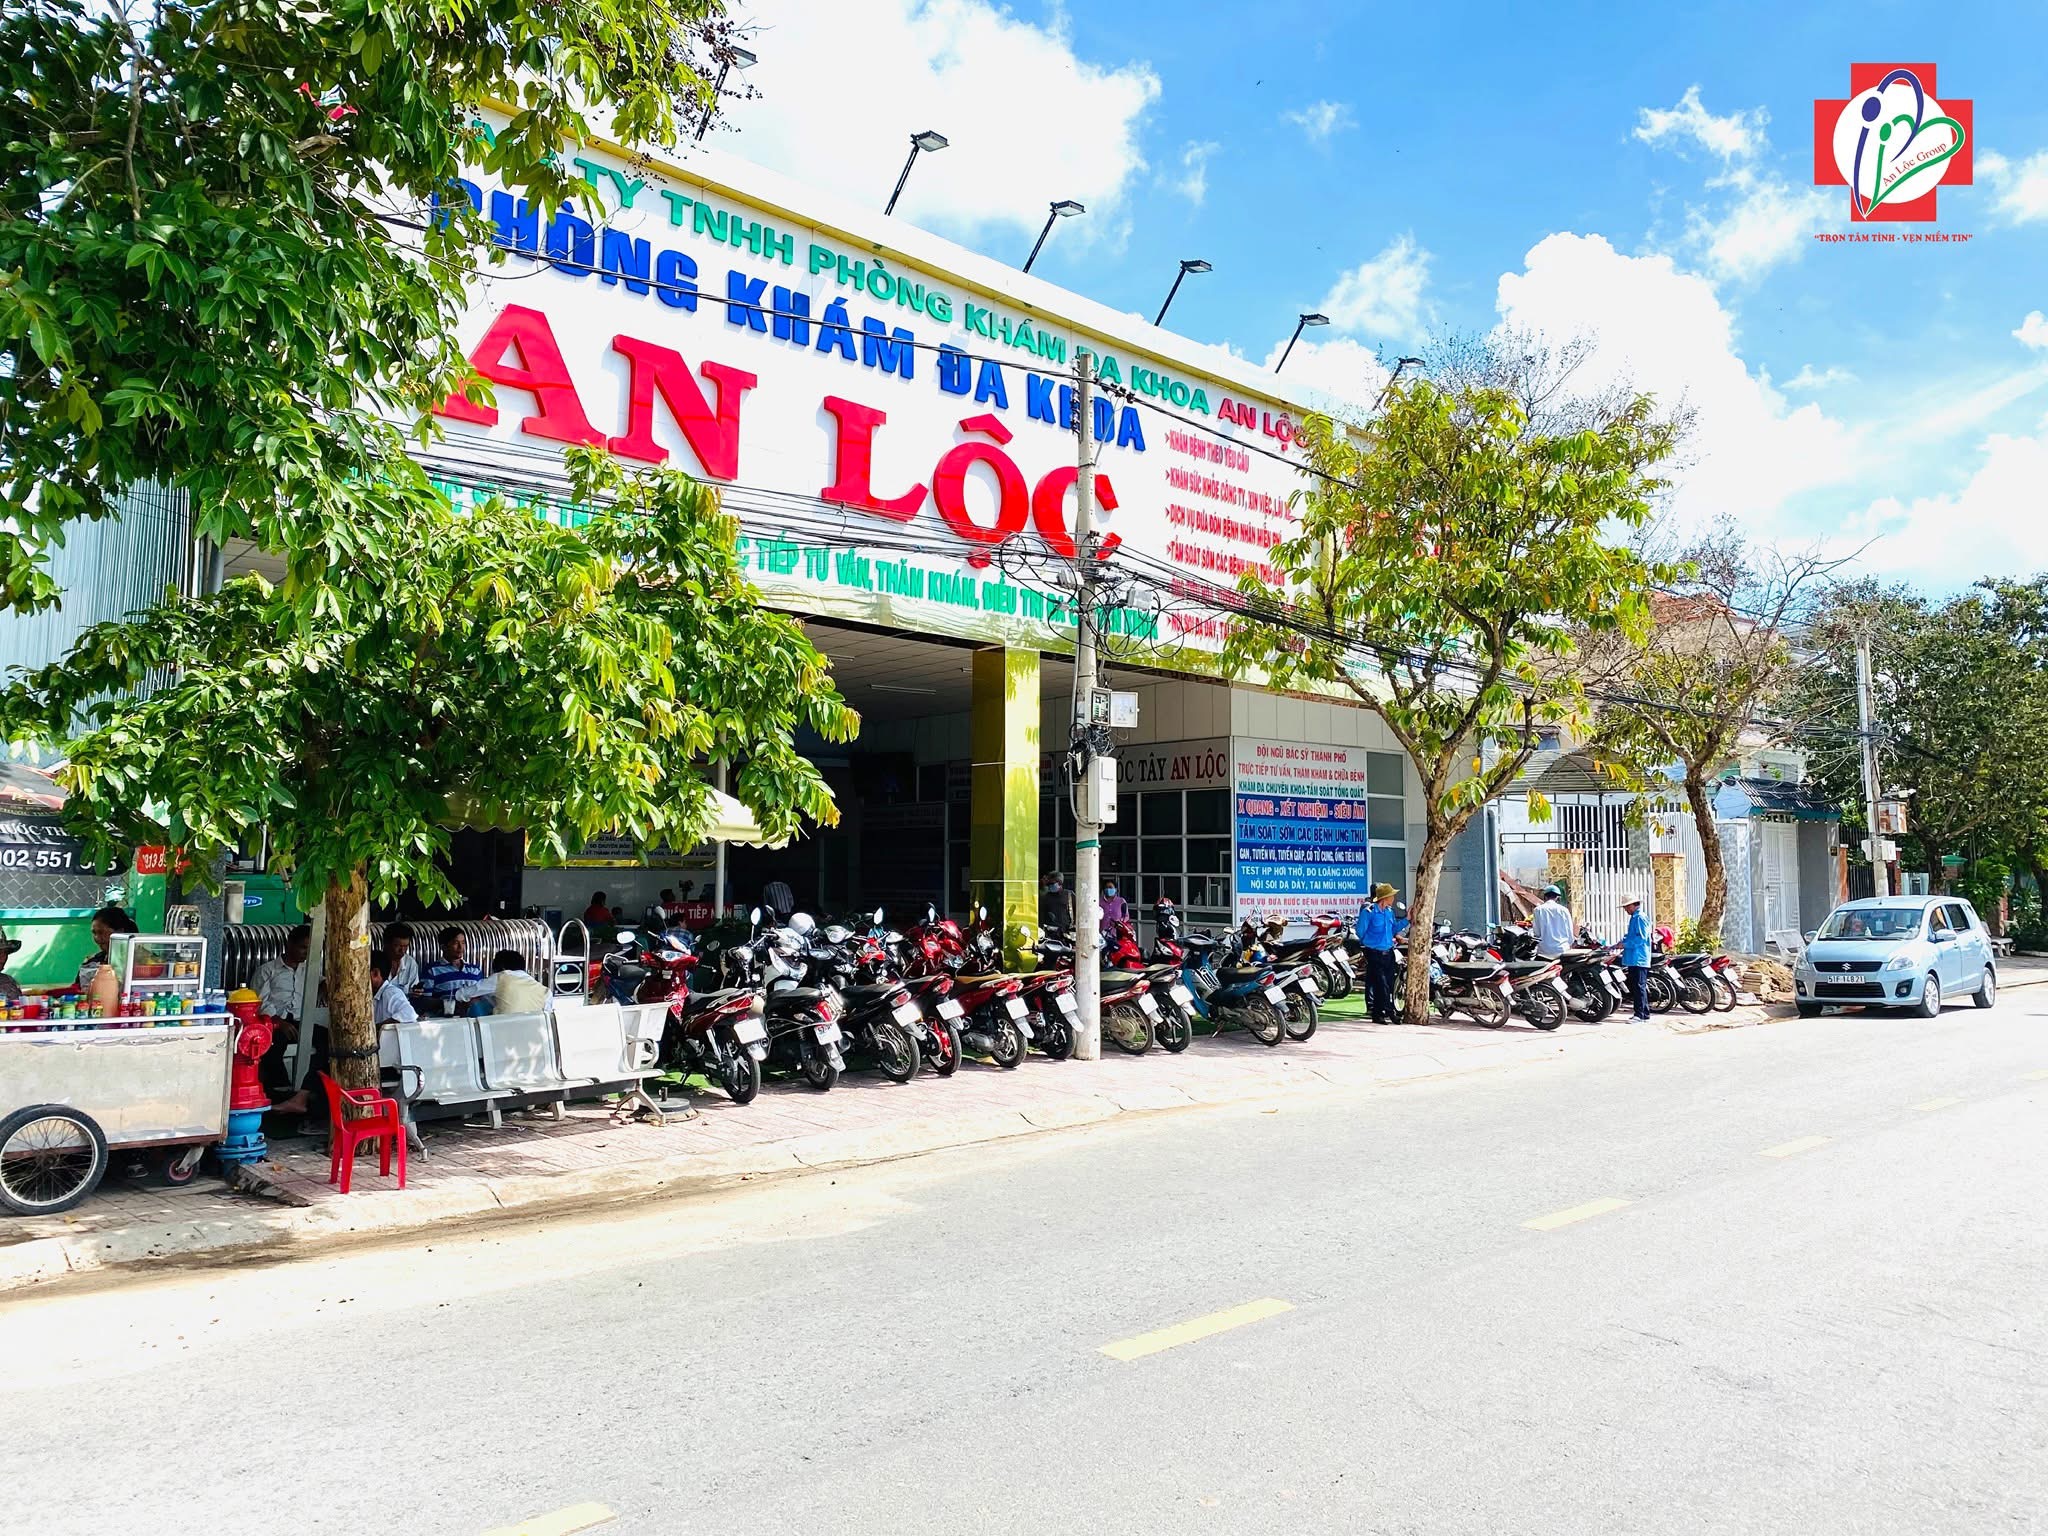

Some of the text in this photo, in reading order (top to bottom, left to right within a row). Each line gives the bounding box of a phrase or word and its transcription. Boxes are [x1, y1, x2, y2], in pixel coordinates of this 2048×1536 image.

[661, 189, 794, 265] TNHH
[810, 245, 952, 322] PHÒNG
[965, 303, 1066, 366] KHÁM
[1131, 364, 1209, 415] KHOA
[1218, 396, 1257, 430] AN
[727, 269, 915, 380] KHÁM
[937, 343, 1010, 410] ĐA
[431, 303, 1123, 569] AN LỘC
[1170, 466, 1188, 492] KHÁM
[755, 529, 800, 575] TIẾP
[835, 548, 874, 592] VẤN,
[876, 558, 925, 599] THĂM
[928, 568, 979, 611] KHÁM,
[1257, 744, 1269, 760] ĐỘI
[1270, 745, 1284, 759] NGŨ
[1286, 746, 1299, 760] BÁC
[1333, 750, 1347, 764] PHỐ
[1139, 755, 1168, 782] TÂY
[1170, 756, 1191, 780] AN
[1196, 747, 1228, 784] LỘC
[1311, 766, 1328, 780] KHÁM
[1328, 770, 1333, 780] &
[1238, 777, 1256, 792] KHÁM
[1256, 780, 1265, 792] ĐA
[1238, 799, 1246, 814] X
[1246, 800, 1274, 817] QUANG
[1297, 799, 1329, 820] NGHIỆM
[1334, 801, 1352, 819] SIÊU
[1257, 821, 1277, 840] SOÁT
[1280, 824, 1296, 841] SỚM
[1298, 823, 1312, 842] CÁC
[1313, 825, 1333, 845] BỆNH
[1335, 828, 1349, 842] UNG
[35, 850, 72, 869] 551
[1241, 866, 1259, 875] TEST
[1262, 867, 1272, 876] HP
[1250, 878, 1263, 890] NỘI
[1265, 880, 1277, 889] SOI
[1280, 881, 1289, 891] DẠ
[1310, 881, 1323, 890] TAI
[1337, 881, 1356, 891] HỌNG
[687, 904, 708, 919] TIẾP
